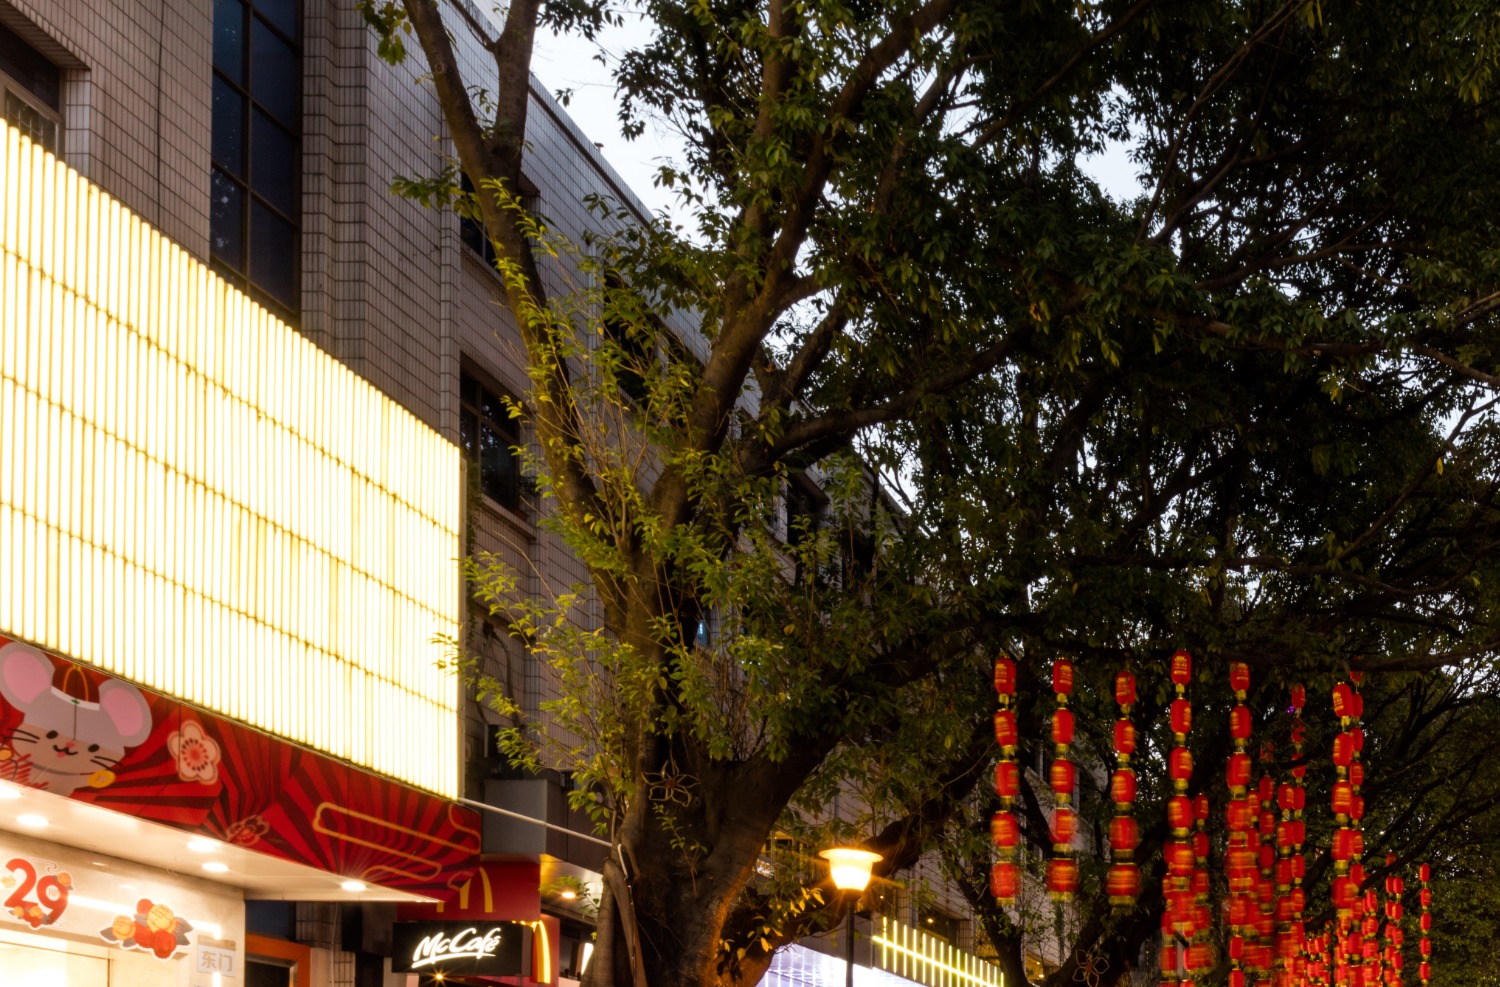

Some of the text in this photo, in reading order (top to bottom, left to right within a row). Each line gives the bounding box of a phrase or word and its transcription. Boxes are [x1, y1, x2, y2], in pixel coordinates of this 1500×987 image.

[4, 857, 69, 926] 29
[201, 950, 233, 972] 东门
[411, 926, 502, 969] McCafé
